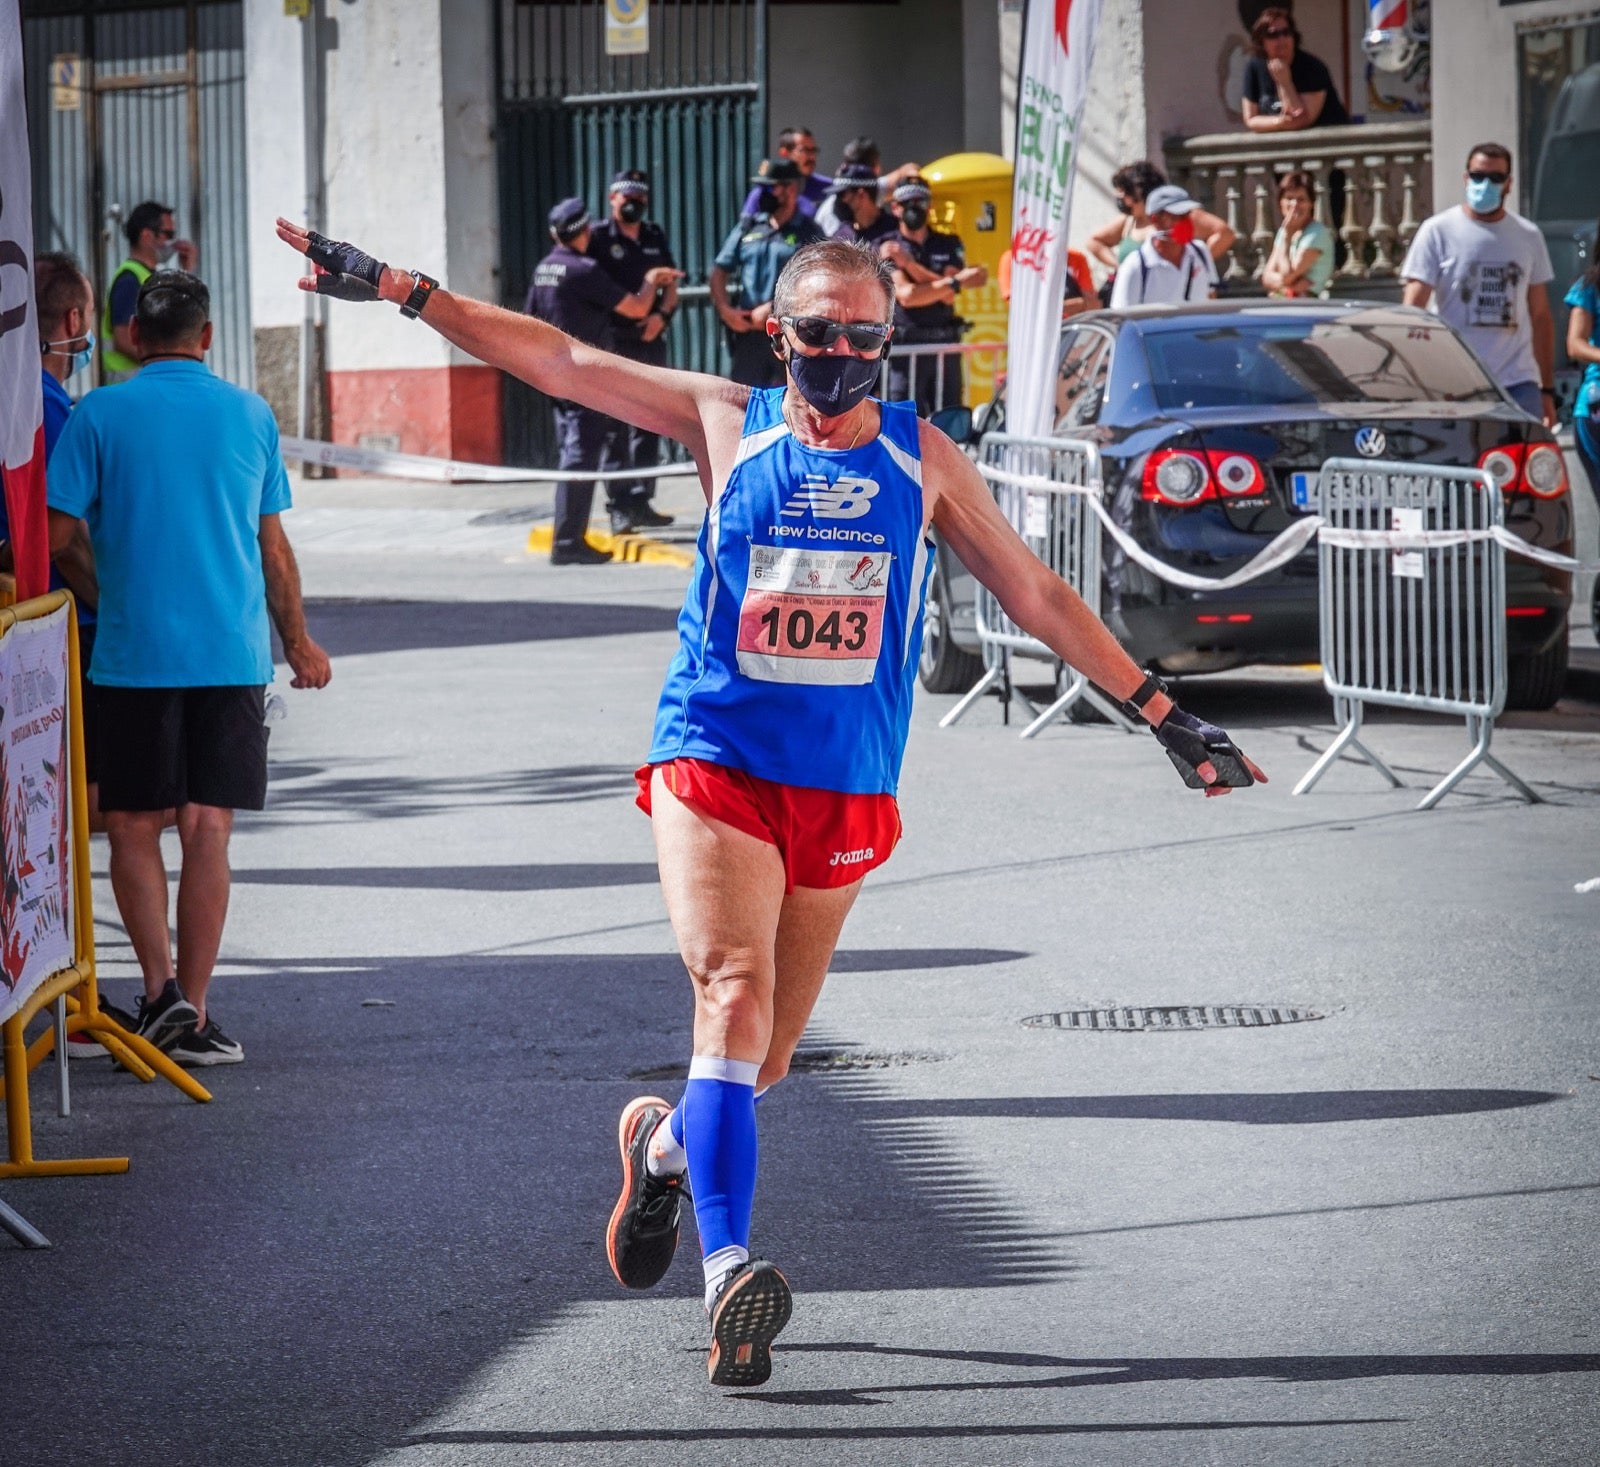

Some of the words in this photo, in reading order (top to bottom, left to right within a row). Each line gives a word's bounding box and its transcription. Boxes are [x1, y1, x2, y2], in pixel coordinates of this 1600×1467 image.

[768, 525, 805, 538] new
[806, 525, 885, 545] balance
[761, 606, 869, 651] 1043
